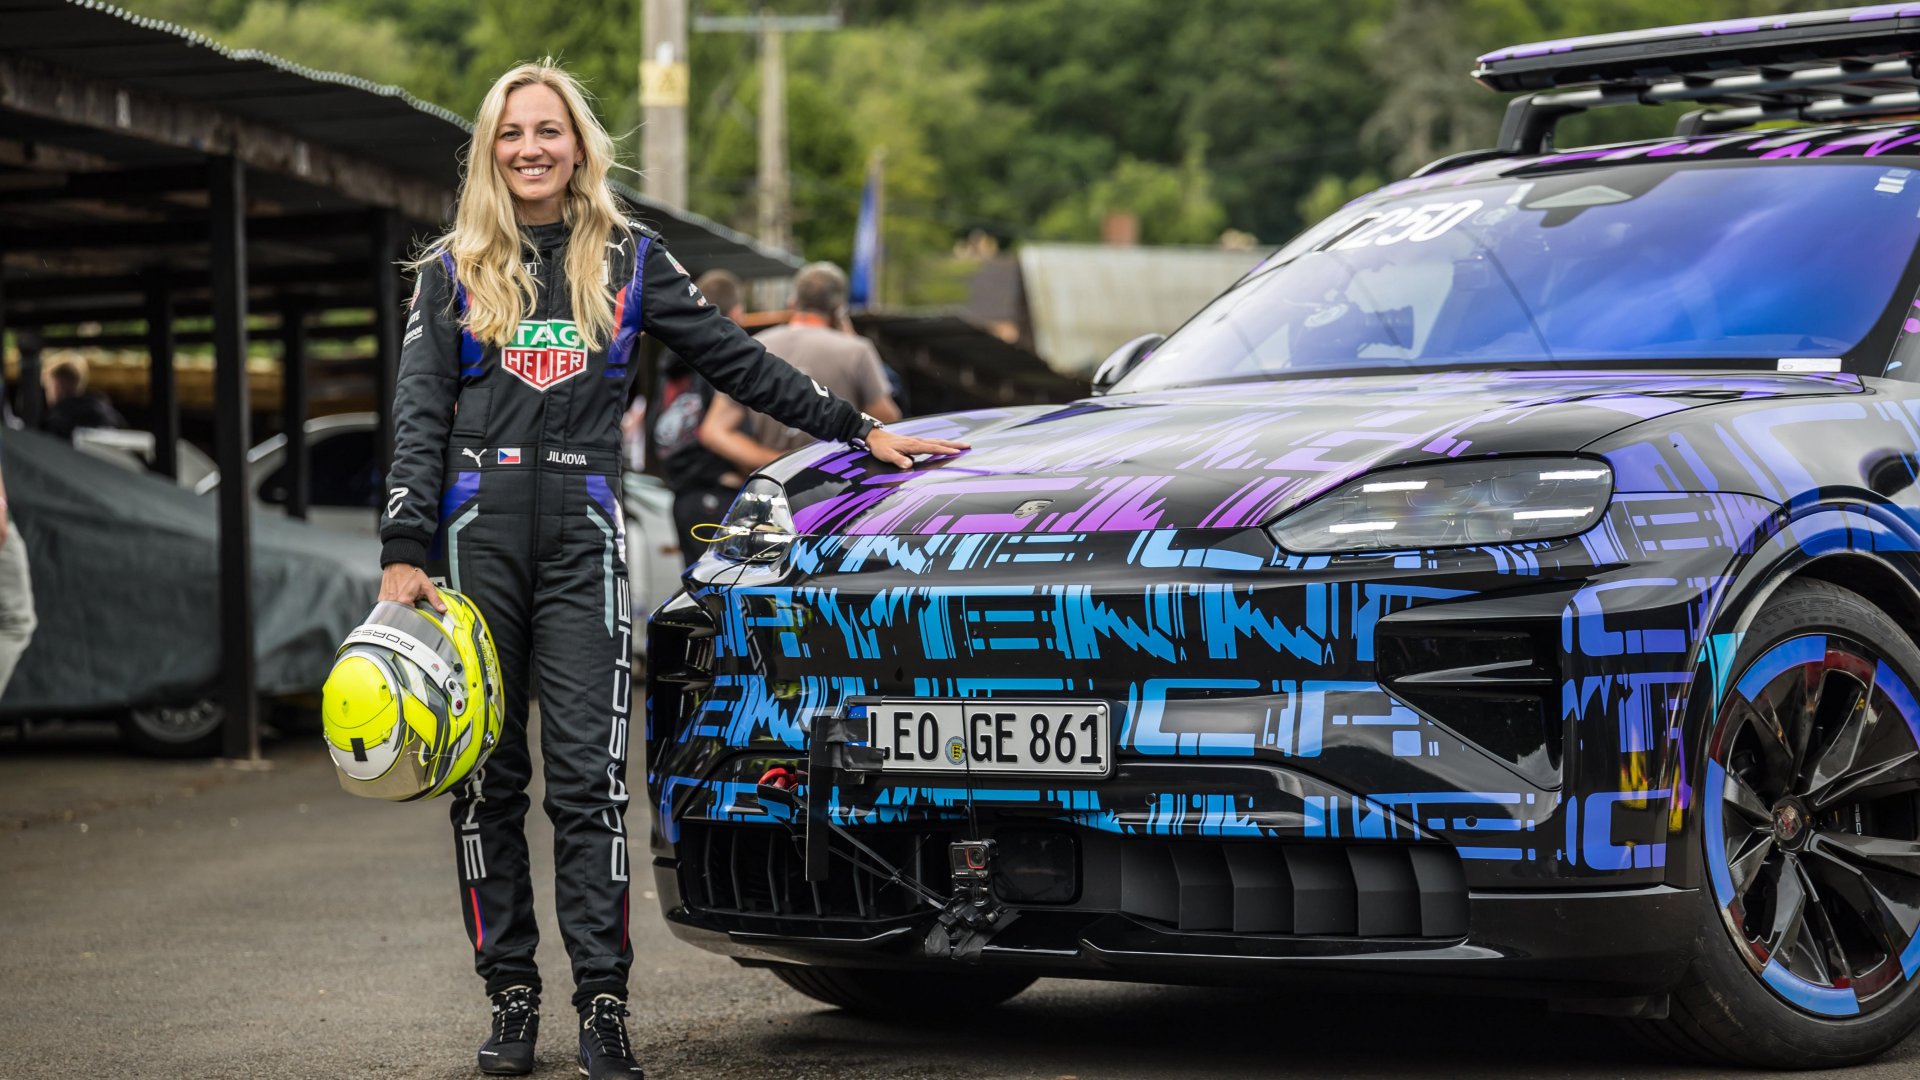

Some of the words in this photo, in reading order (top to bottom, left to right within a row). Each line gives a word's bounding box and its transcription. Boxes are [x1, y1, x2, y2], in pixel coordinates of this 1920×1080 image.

[515, 325, 581, 346] TAG
[507, 351, 583, 384] HEUER
[546, 450, 588, 466] JILKOVA
[603, 577, 631, 882] PORSCHE
[869, 711, 940, 762] LEO
[970, 712, 1018, 763] GE
[1029, 712, 1103, 764] 861
